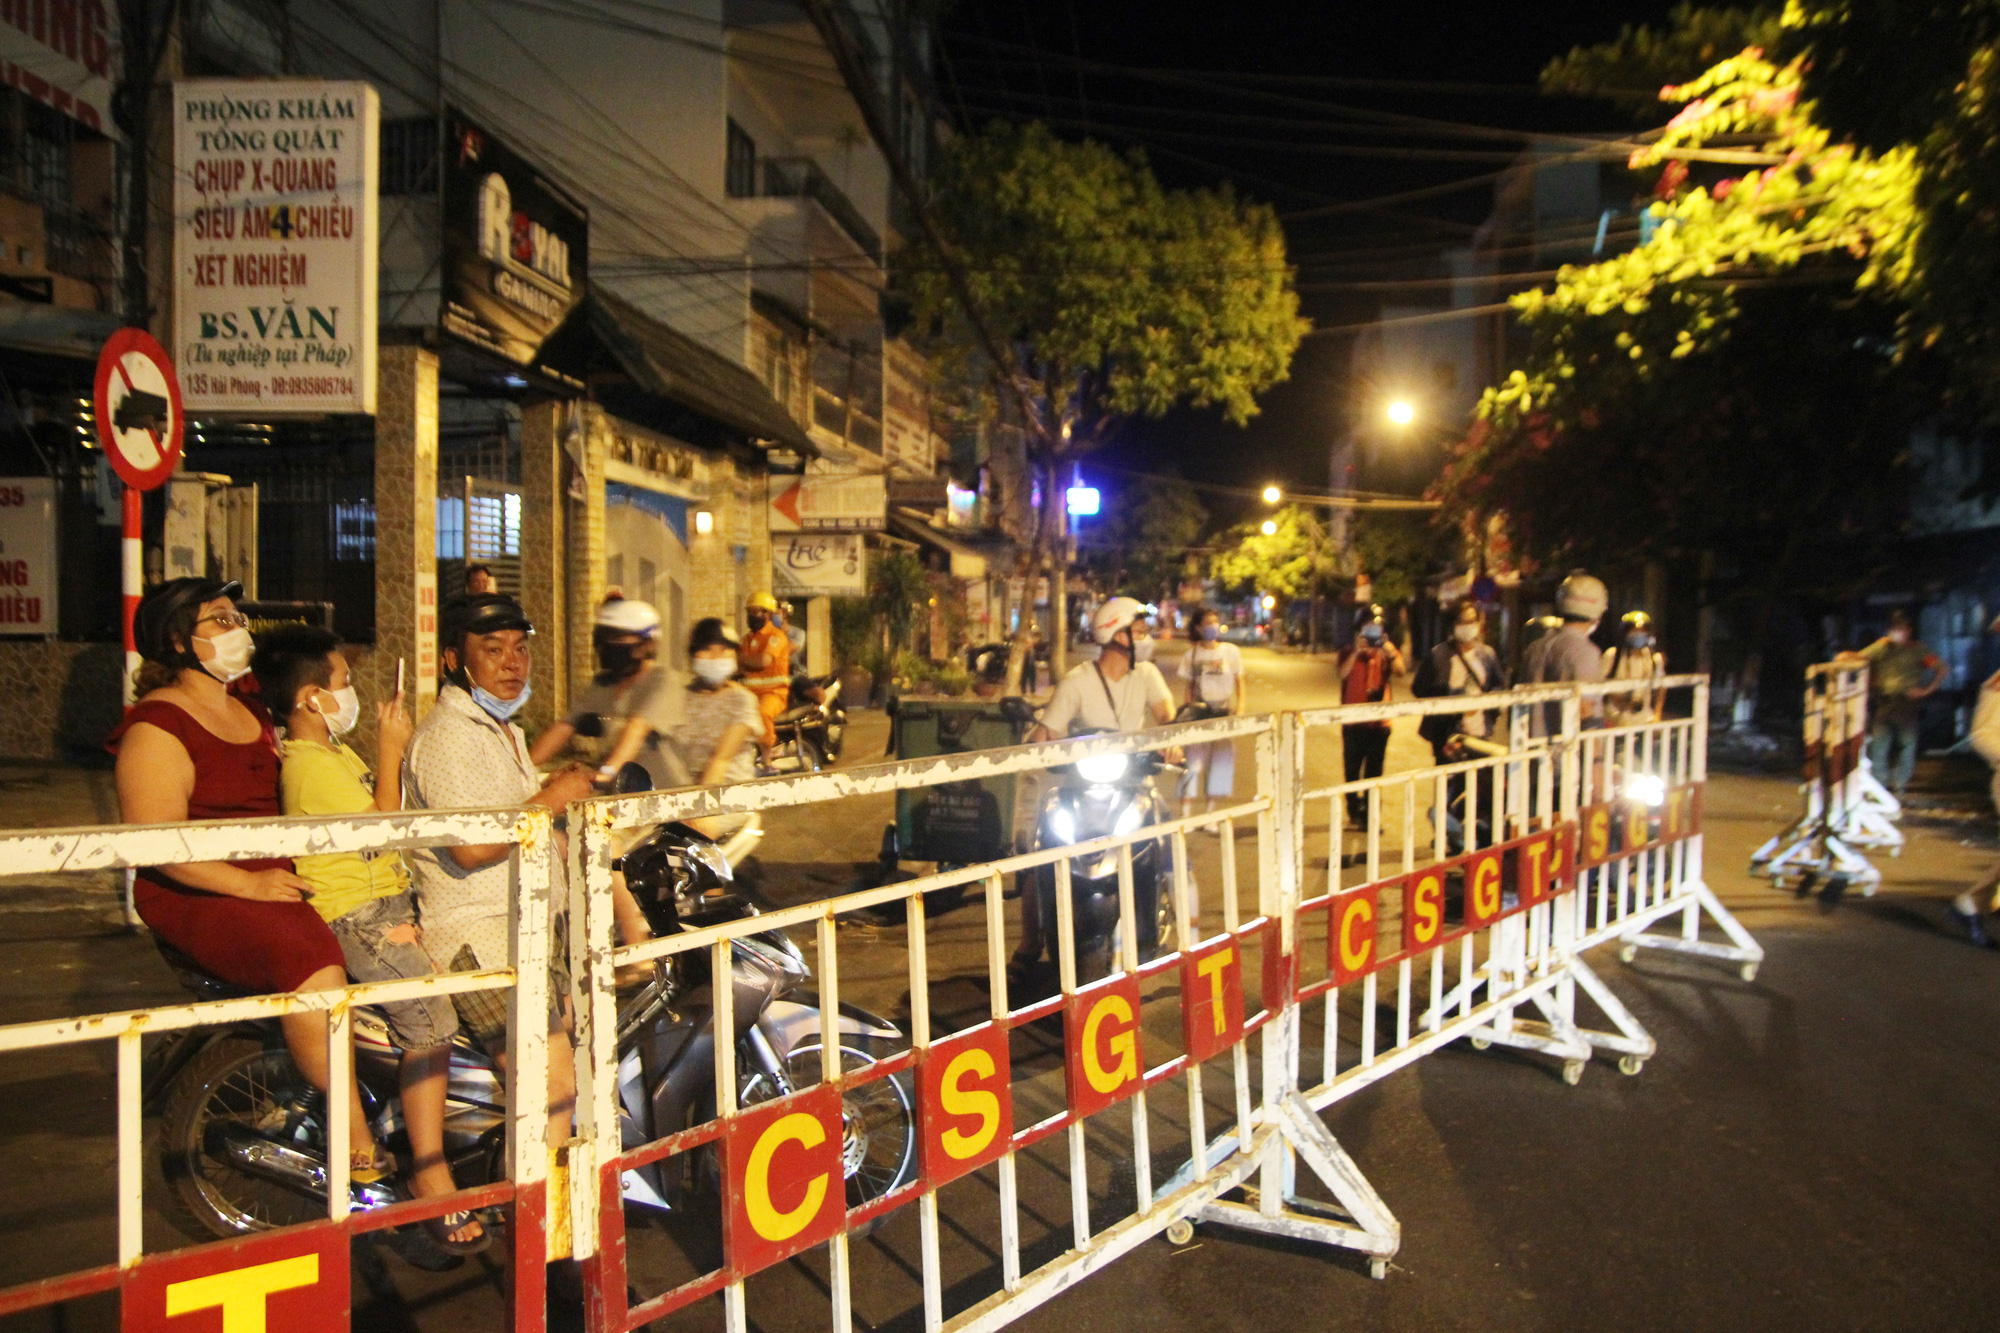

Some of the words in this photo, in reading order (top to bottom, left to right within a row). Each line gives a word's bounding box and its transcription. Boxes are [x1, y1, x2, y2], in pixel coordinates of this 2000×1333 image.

[186, 94, 271, 121] PHÒNG
[277, 92, 355, 119] KHÁM
[273, 124, 344, 154] QUÁT
[194, 158, 246, 198] CHỤP
[251, 157, 337, 194] X-QUANG
[194, 199, 235, 239] SIÊU
[242, 198, 270, 238] ÂM
[271, 205, 294, 238] 4
[295, 194, 353, 238] CHIỀU
[233, 245, 307, 293] NGHIỆM
[218, 342, 271, 367] nghiệp
[186, 373, 208, 395] 135
[734, 976, 765, 992] HONDA
